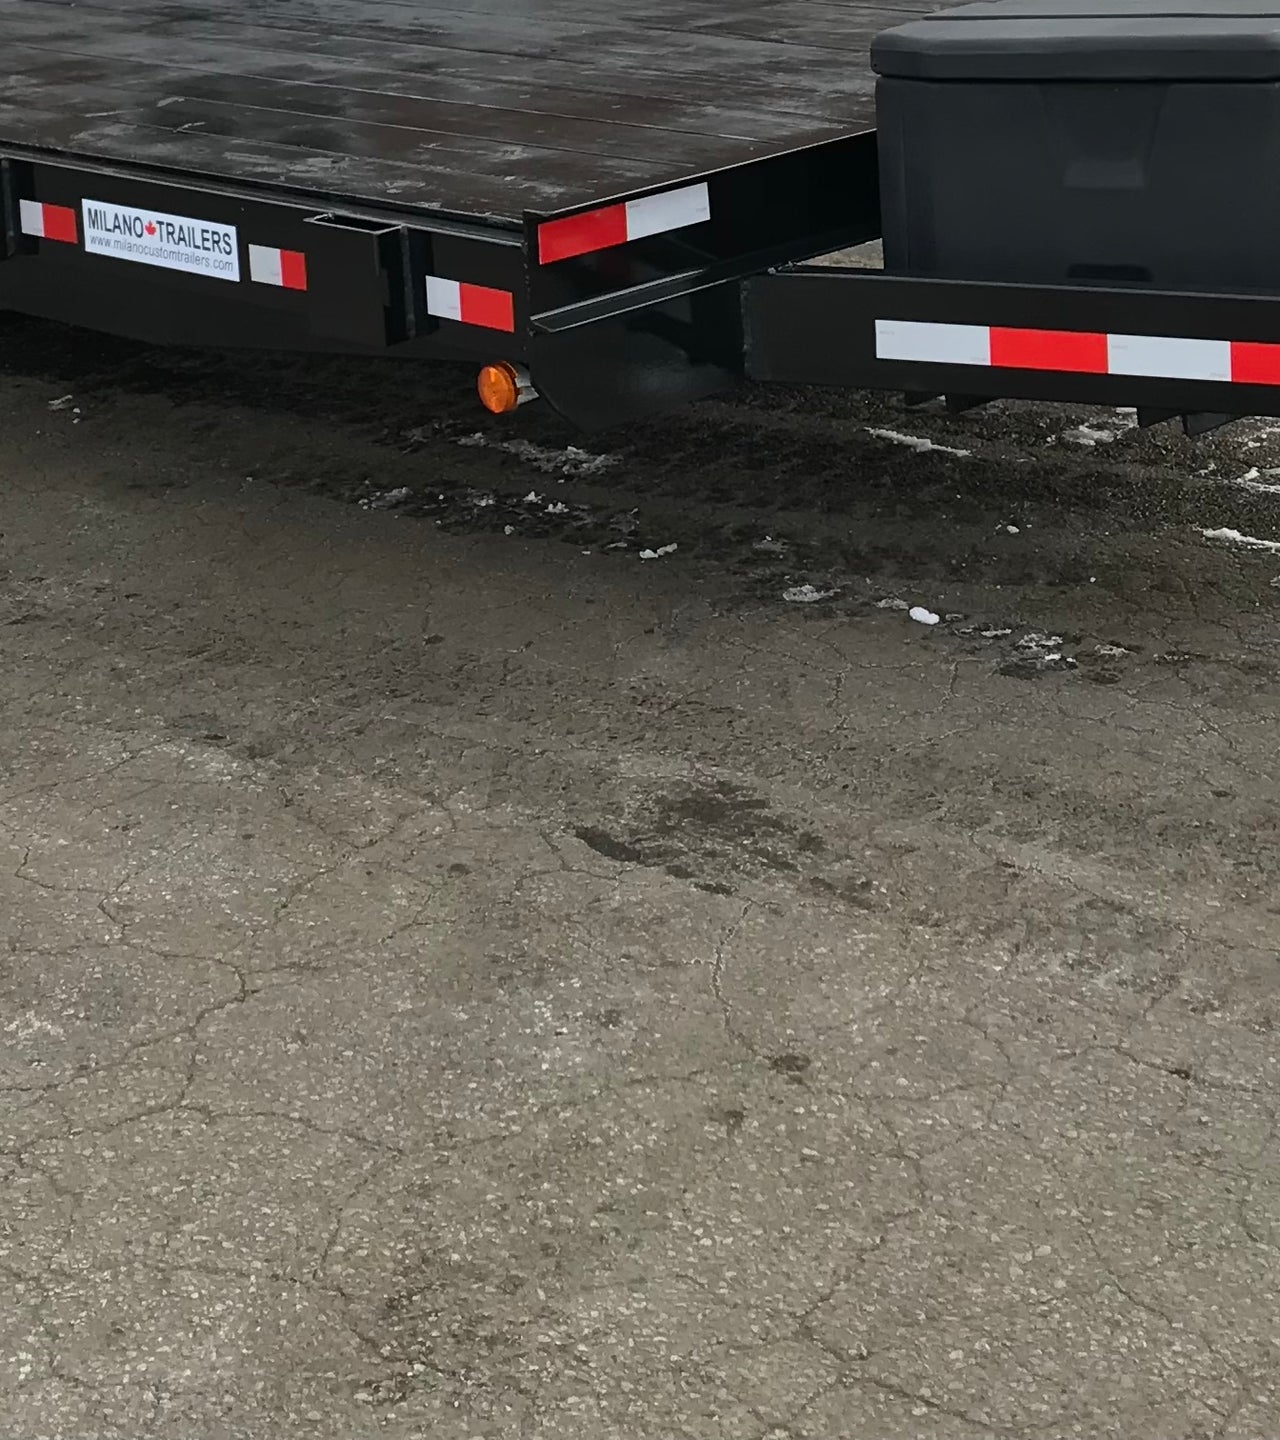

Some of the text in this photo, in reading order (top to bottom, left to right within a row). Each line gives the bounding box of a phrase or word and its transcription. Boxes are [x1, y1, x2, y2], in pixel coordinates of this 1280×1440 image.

[87, 207, 233, 256] MILANO TRAILERS
[89, 234, 234, 272] www.milanocustomtrailers.com
